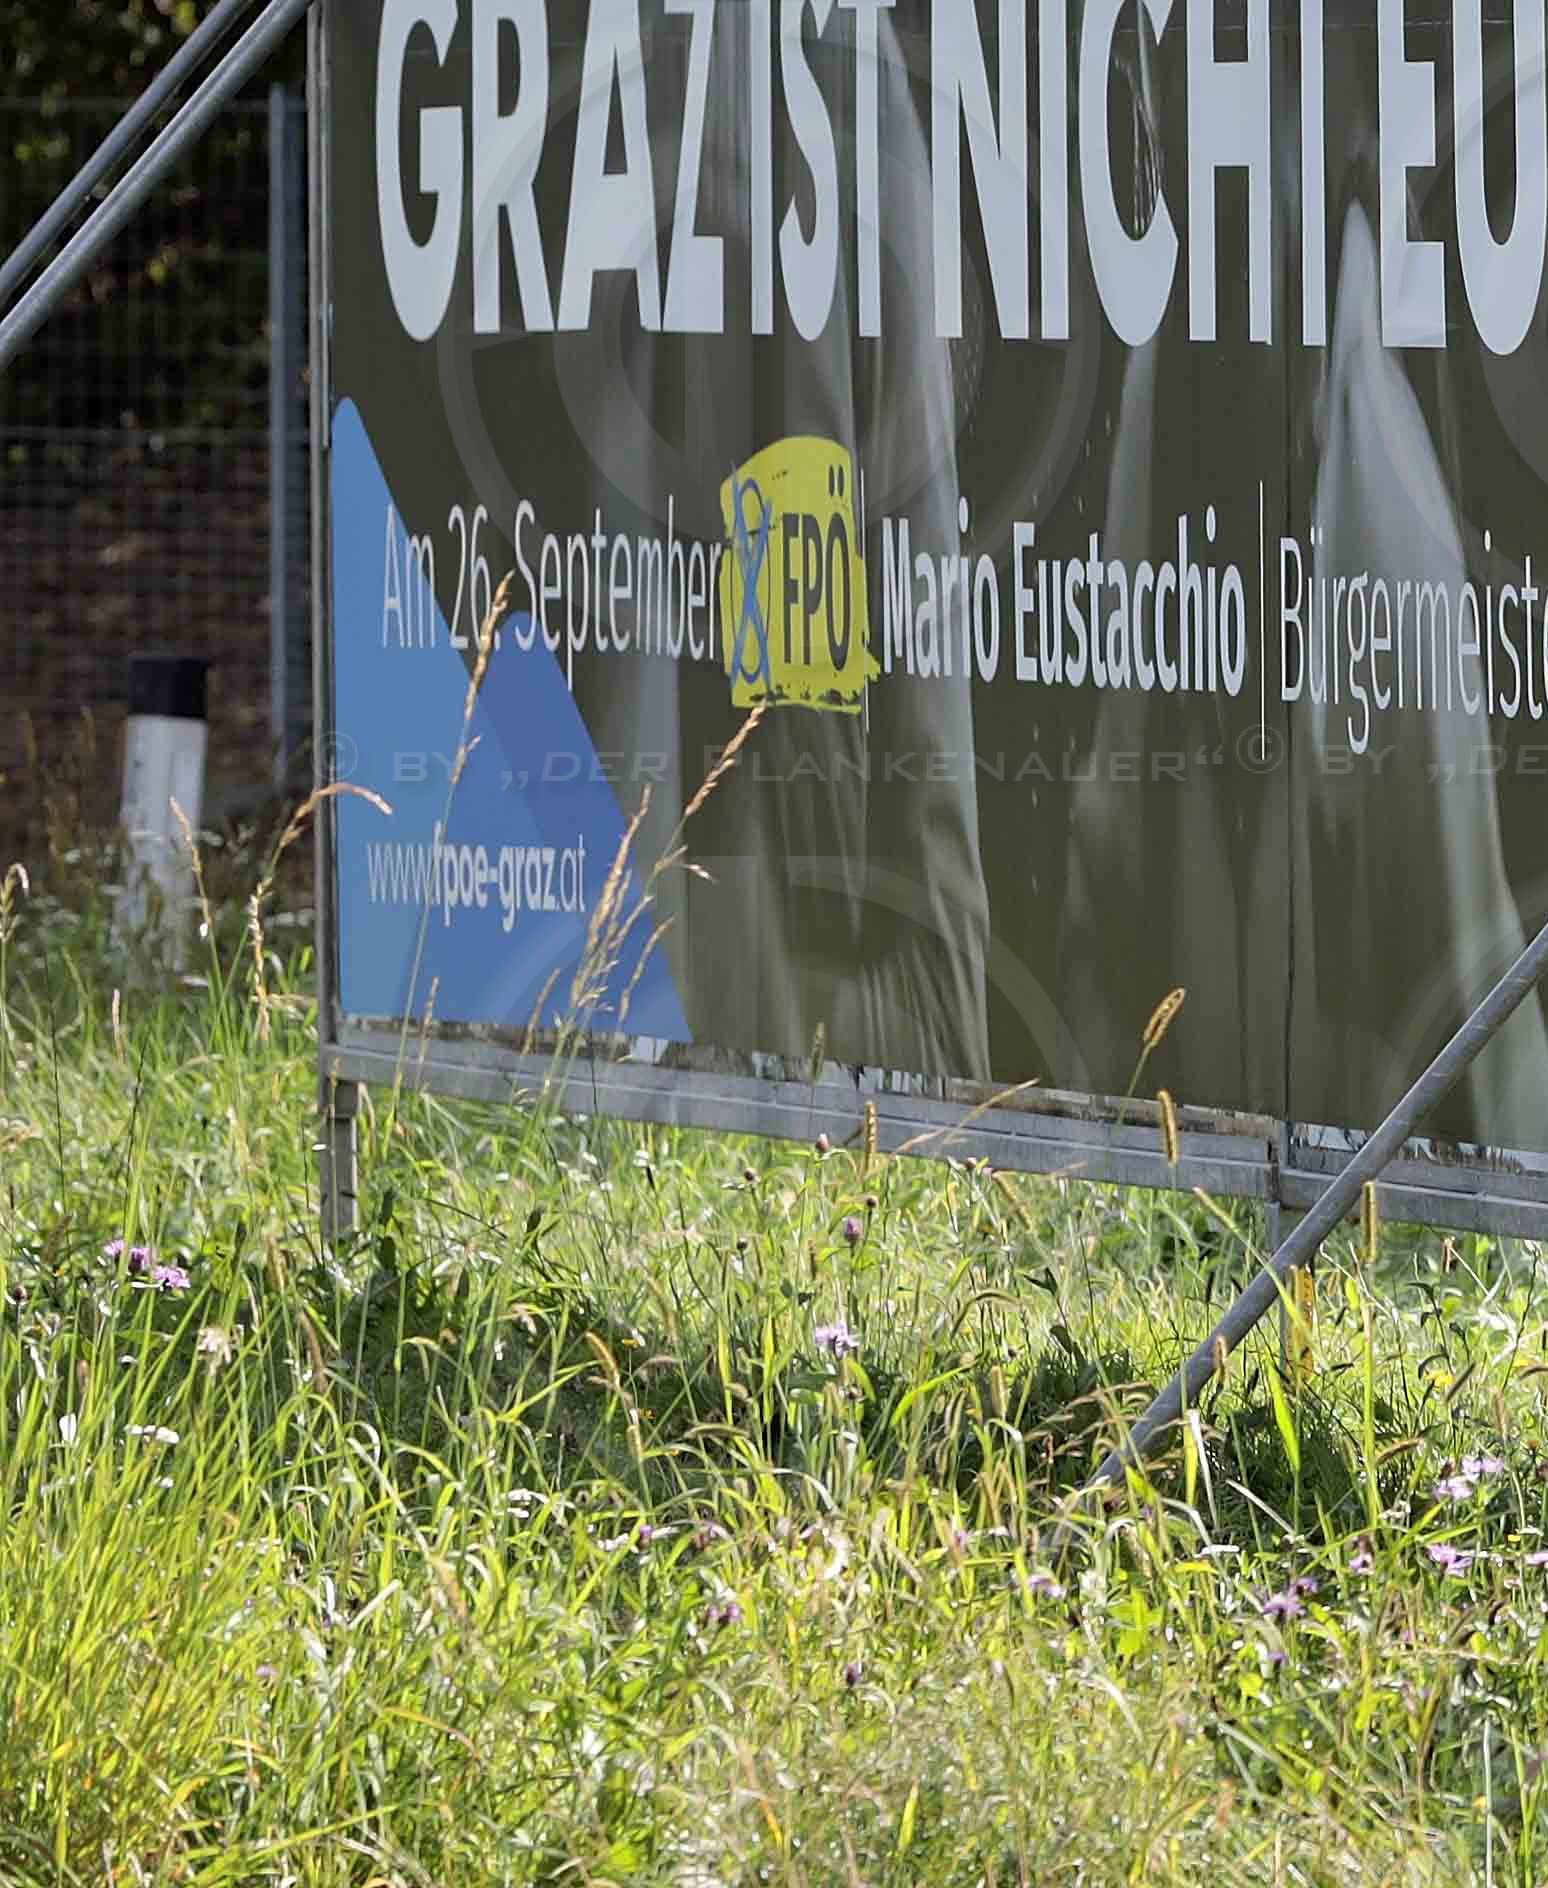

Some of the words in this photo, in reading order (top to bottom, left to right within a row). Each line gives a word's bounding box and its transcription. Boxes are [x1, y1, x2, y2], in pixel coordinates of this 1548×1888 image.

[382, 505, 435, 649] Am
[513, 495, 722, 690] September
[782, 465, 851, 671] FPÖ
[882, 496, 999, 682] Mario
[1013, 504, 1247, 697] Eustacchio
